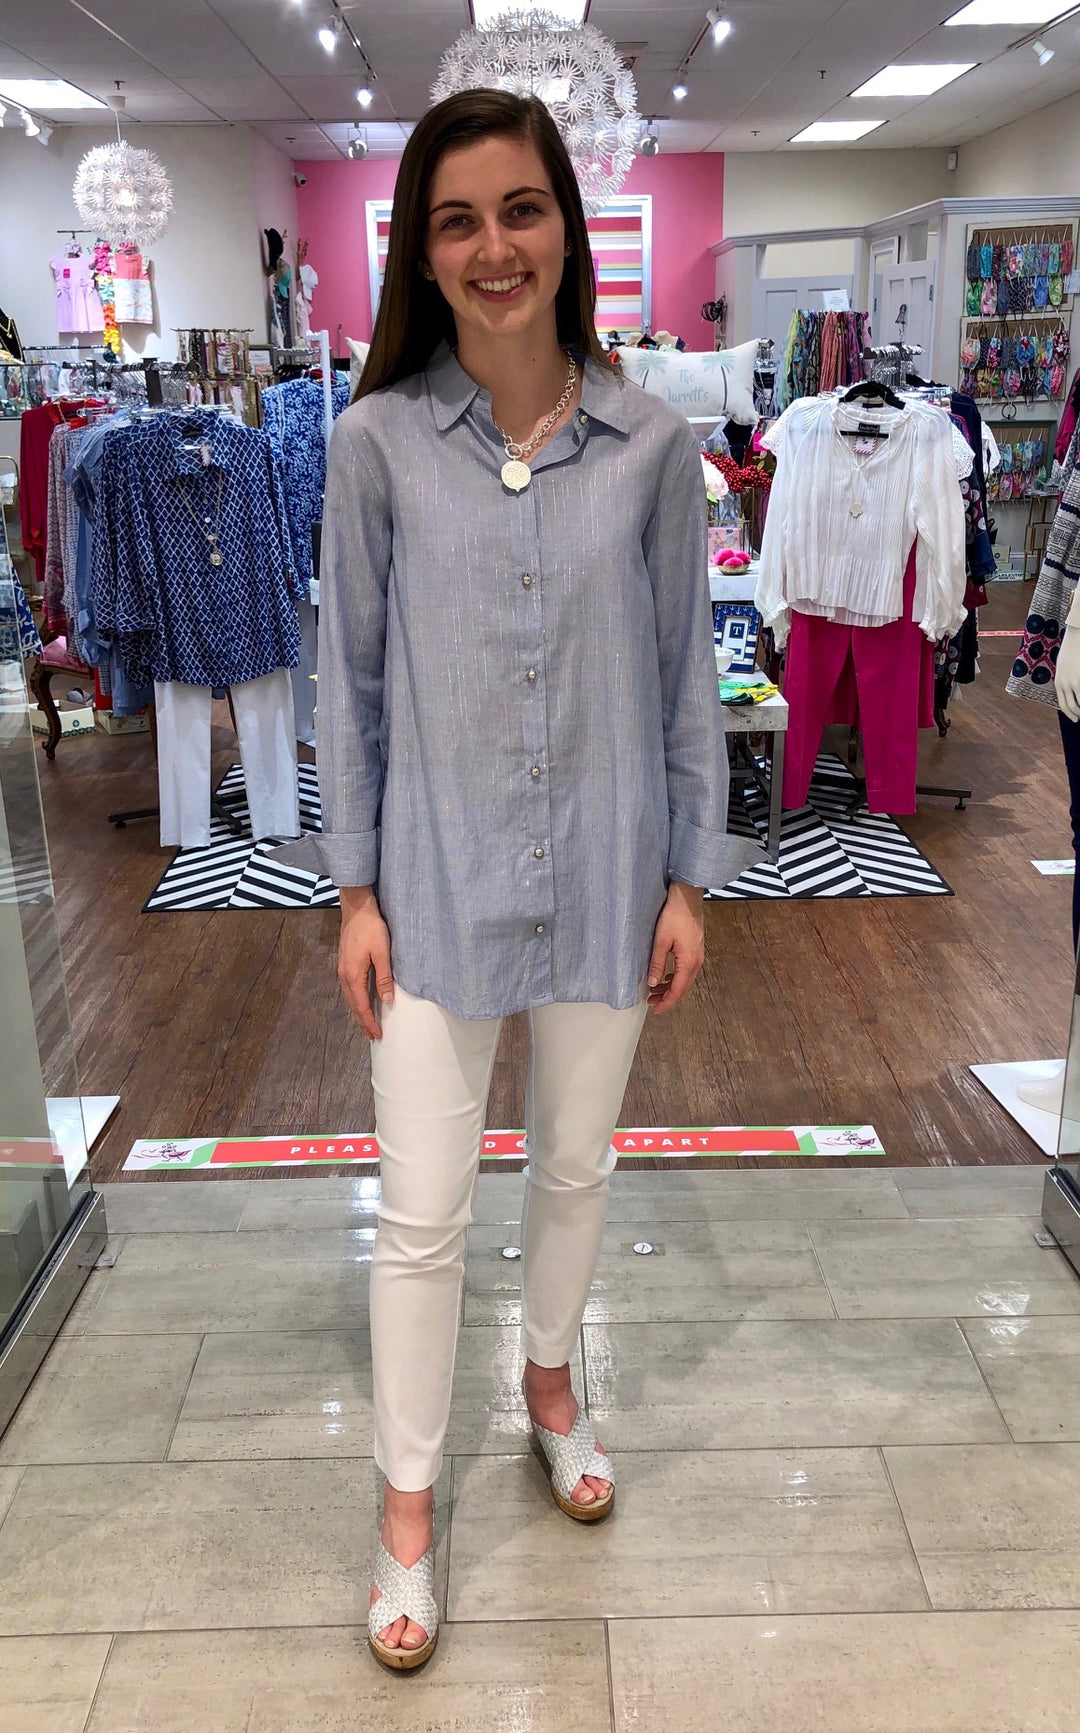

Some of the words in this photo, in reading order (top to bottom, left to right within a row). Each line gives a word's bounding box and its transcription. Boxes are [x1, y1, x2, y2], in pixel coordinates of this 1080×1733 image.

[676, 369, 695, 384] The
[732, 626, 742, 635] T
[290, 1144, 373, 1155] PLEAS
[623, 1137, 709, 1146] APART
